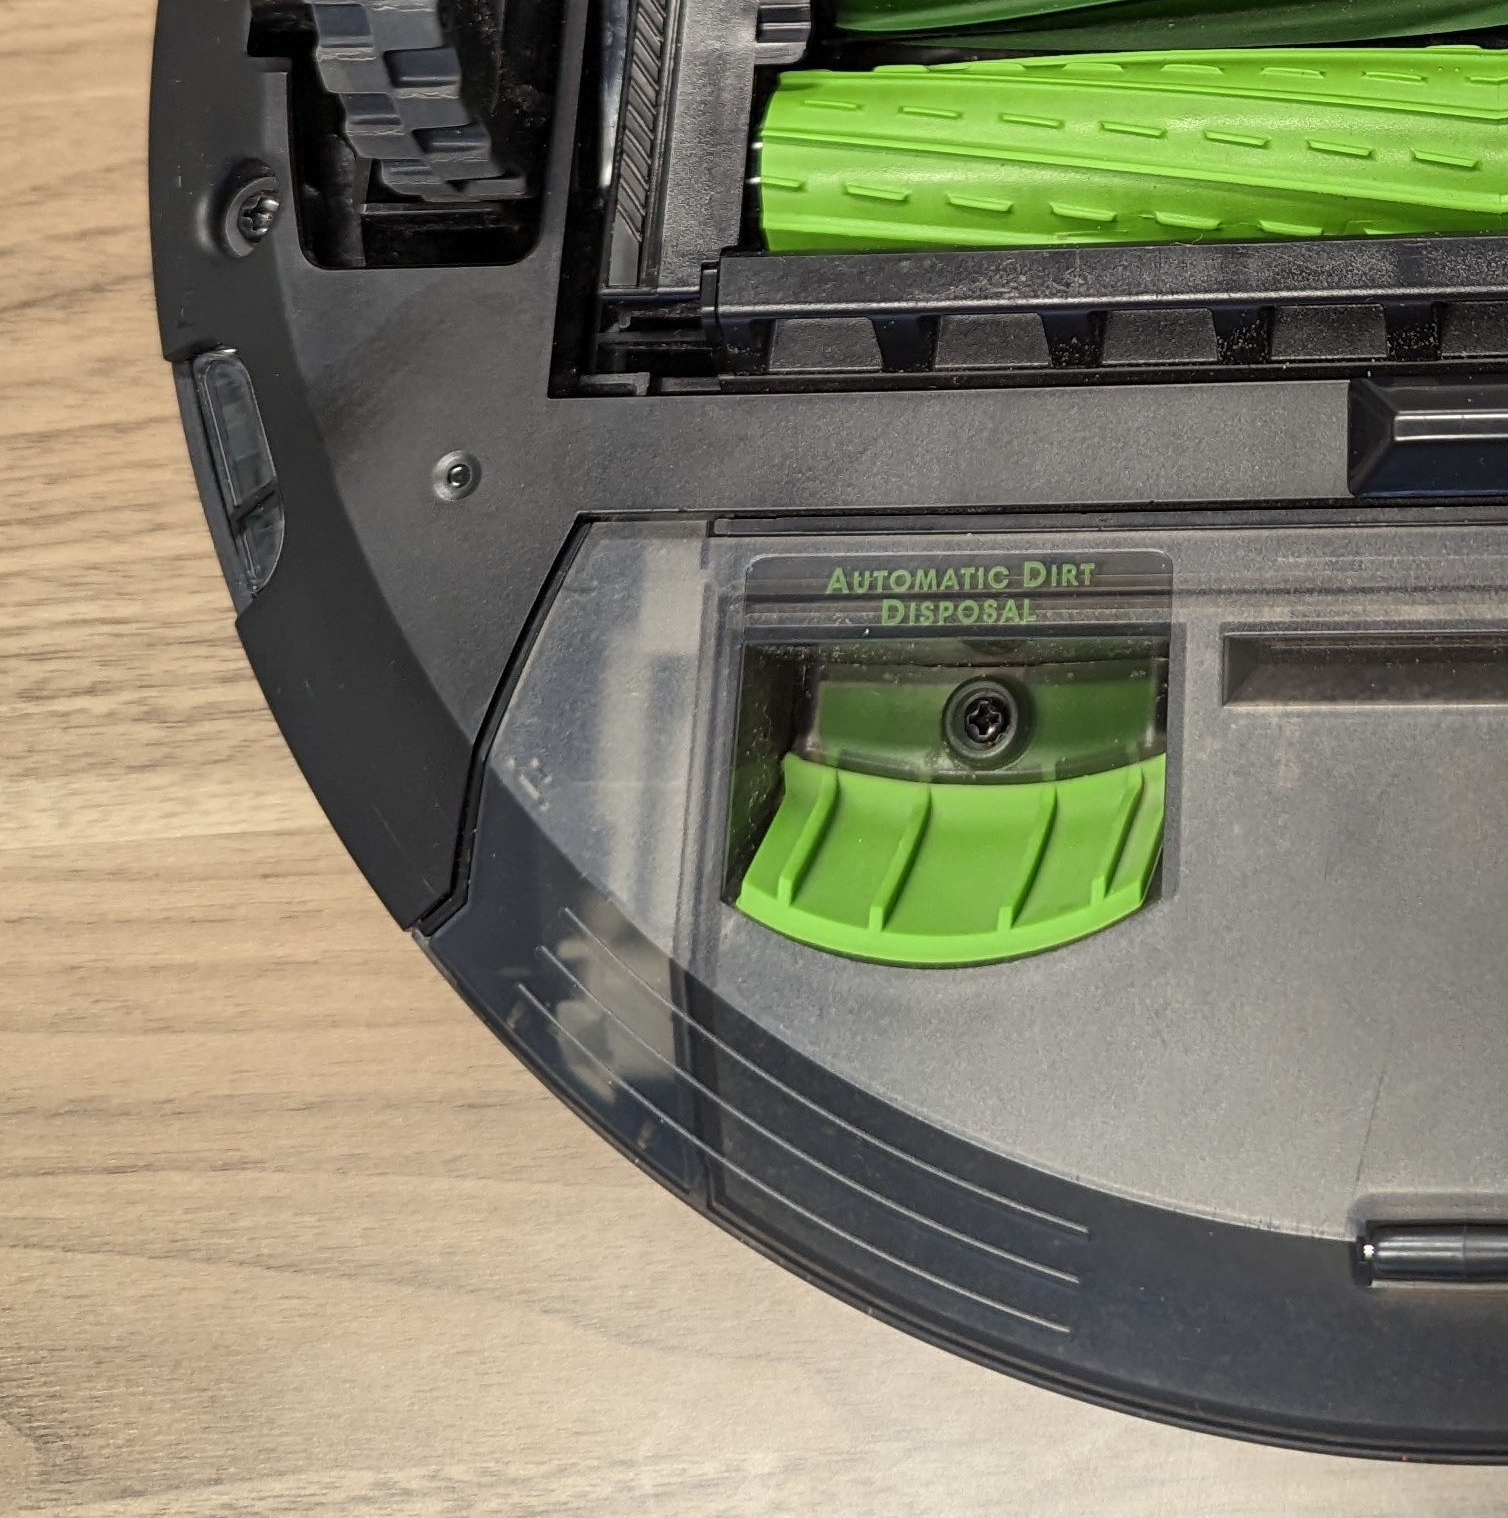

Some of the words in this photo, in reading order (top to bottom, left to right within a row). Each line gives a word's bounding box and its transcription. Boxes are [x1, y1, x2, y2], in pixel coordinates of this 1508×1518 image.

[825, 565, 1010, 595] AUTOMATIC
[1023, 560, 1096, 588] DIRT
[880, 597, 1038, 627] DISPOSAL
